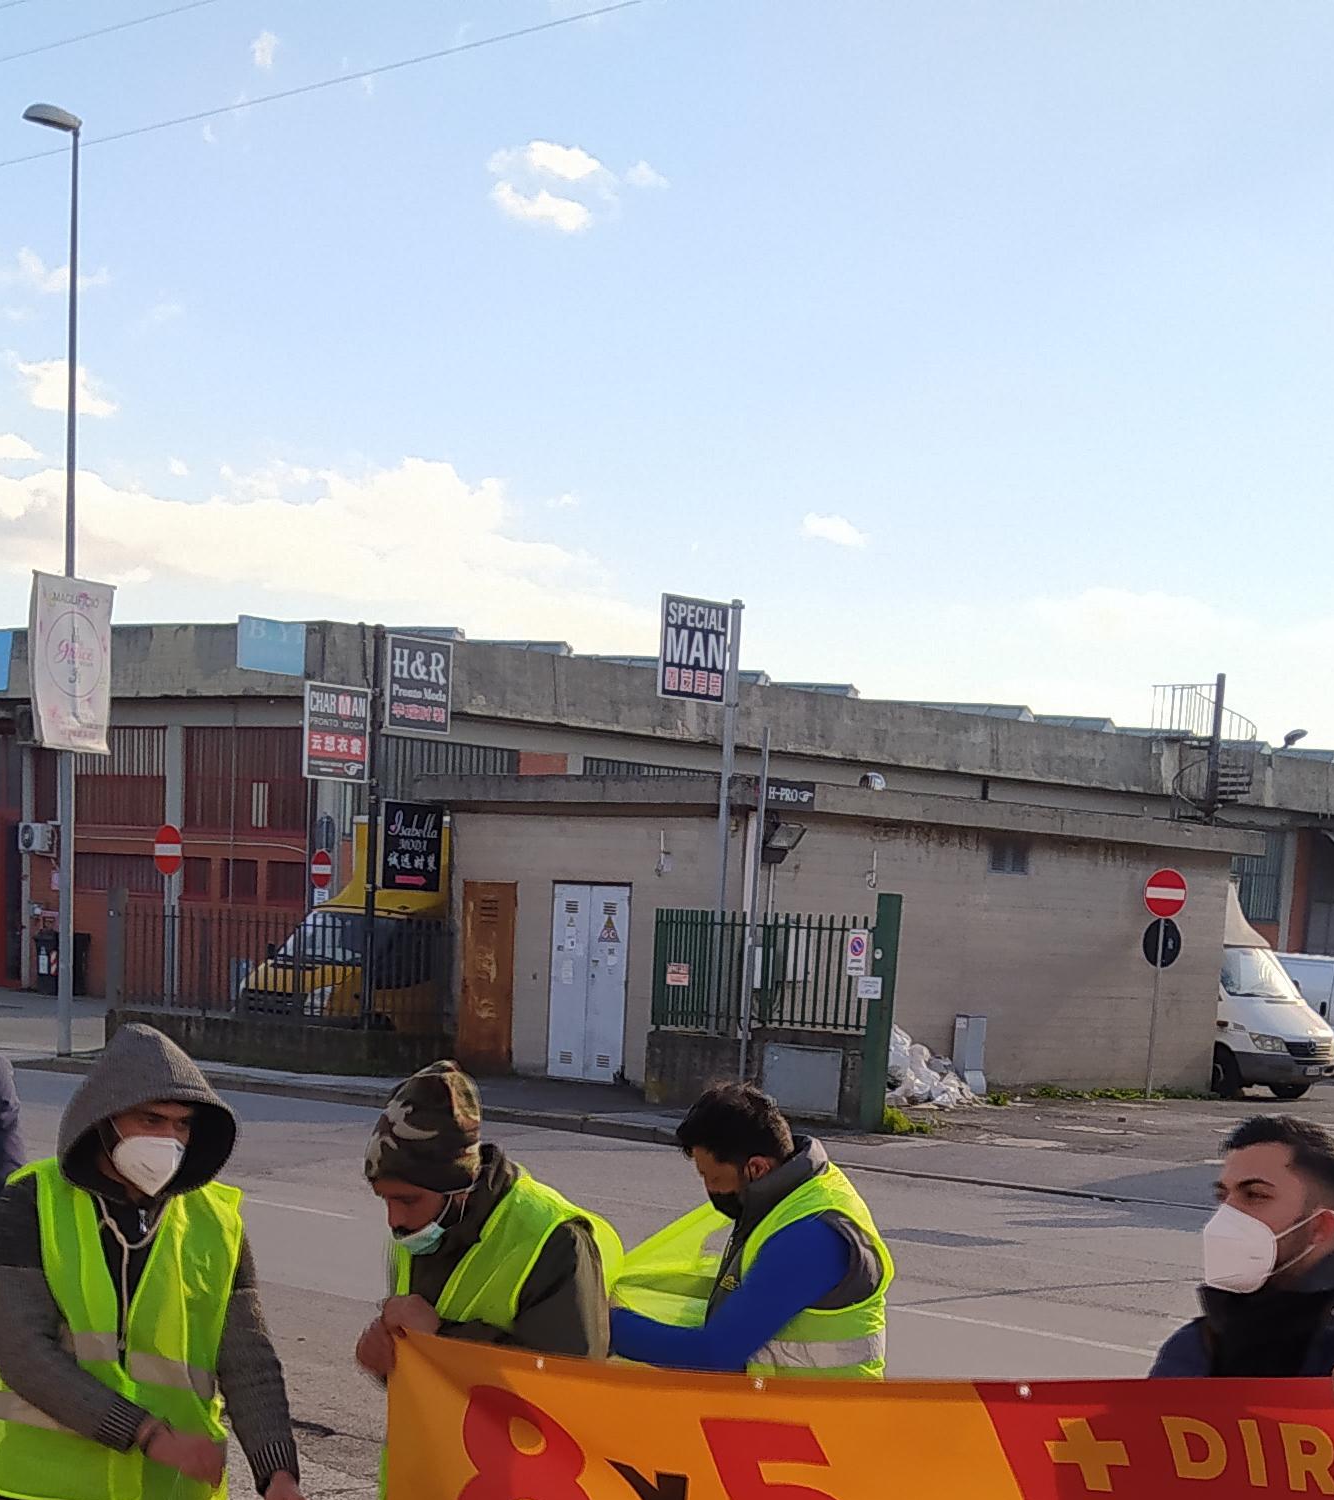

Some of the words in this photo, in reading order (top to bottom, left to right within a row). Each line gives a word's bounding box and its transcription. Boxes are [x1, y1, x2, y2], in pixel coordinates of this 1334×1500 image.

[667, 601, 726, 633] SPECIAL
[666, 626, 726, 671] MAN
[392, 647, 448, 686] H&R
[768, 785, 799, 804] H-PRO
[387, 809, 439, 840] Isabella
